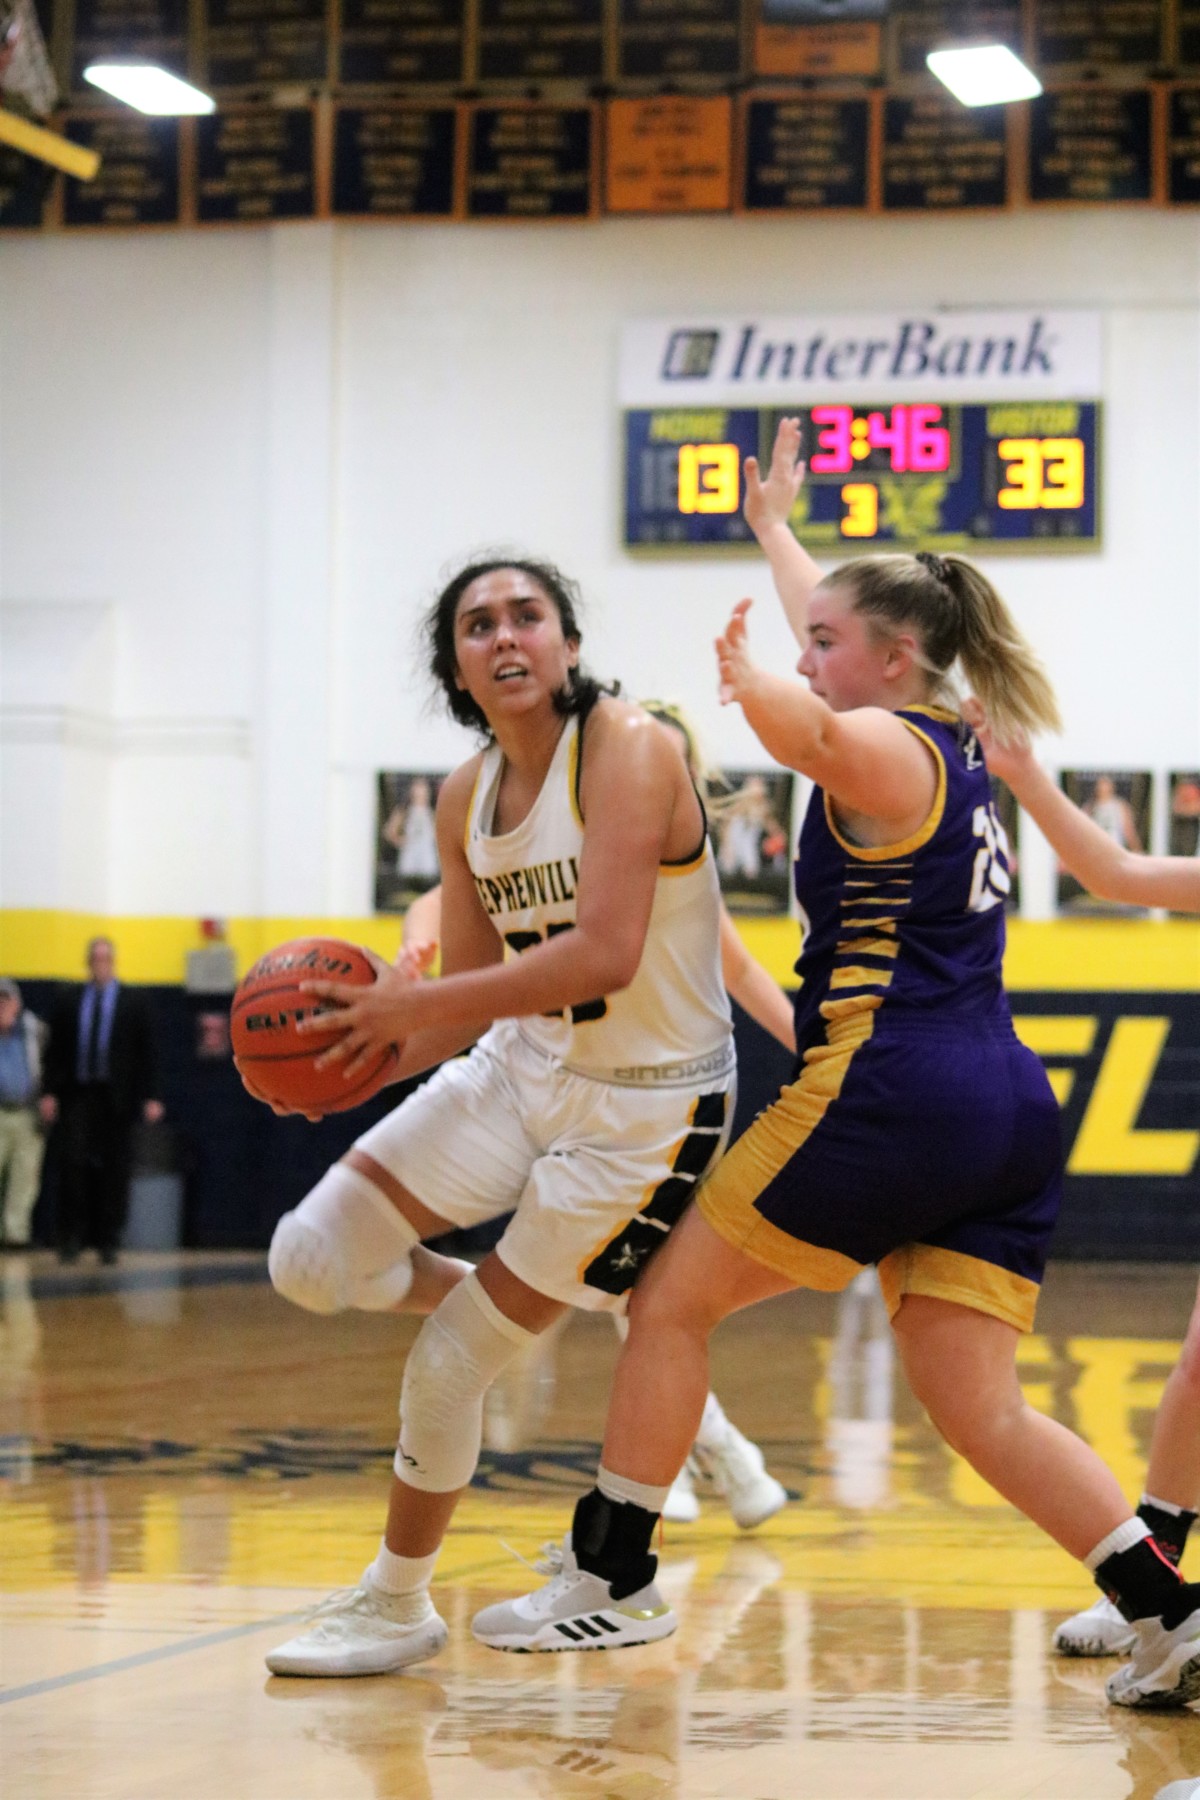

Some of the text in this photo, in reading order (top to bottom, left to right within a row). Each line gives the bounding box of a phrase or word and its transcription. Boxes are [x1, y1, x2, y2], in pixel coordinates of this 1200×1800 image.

[729, 317, 1056, 380] InterBank
[810, 403, 950, 473] 3:46
[678, 443, 740, 514] 13
[998, 438, 1085, 509] 33
[840, 483, 878, 537] 3
